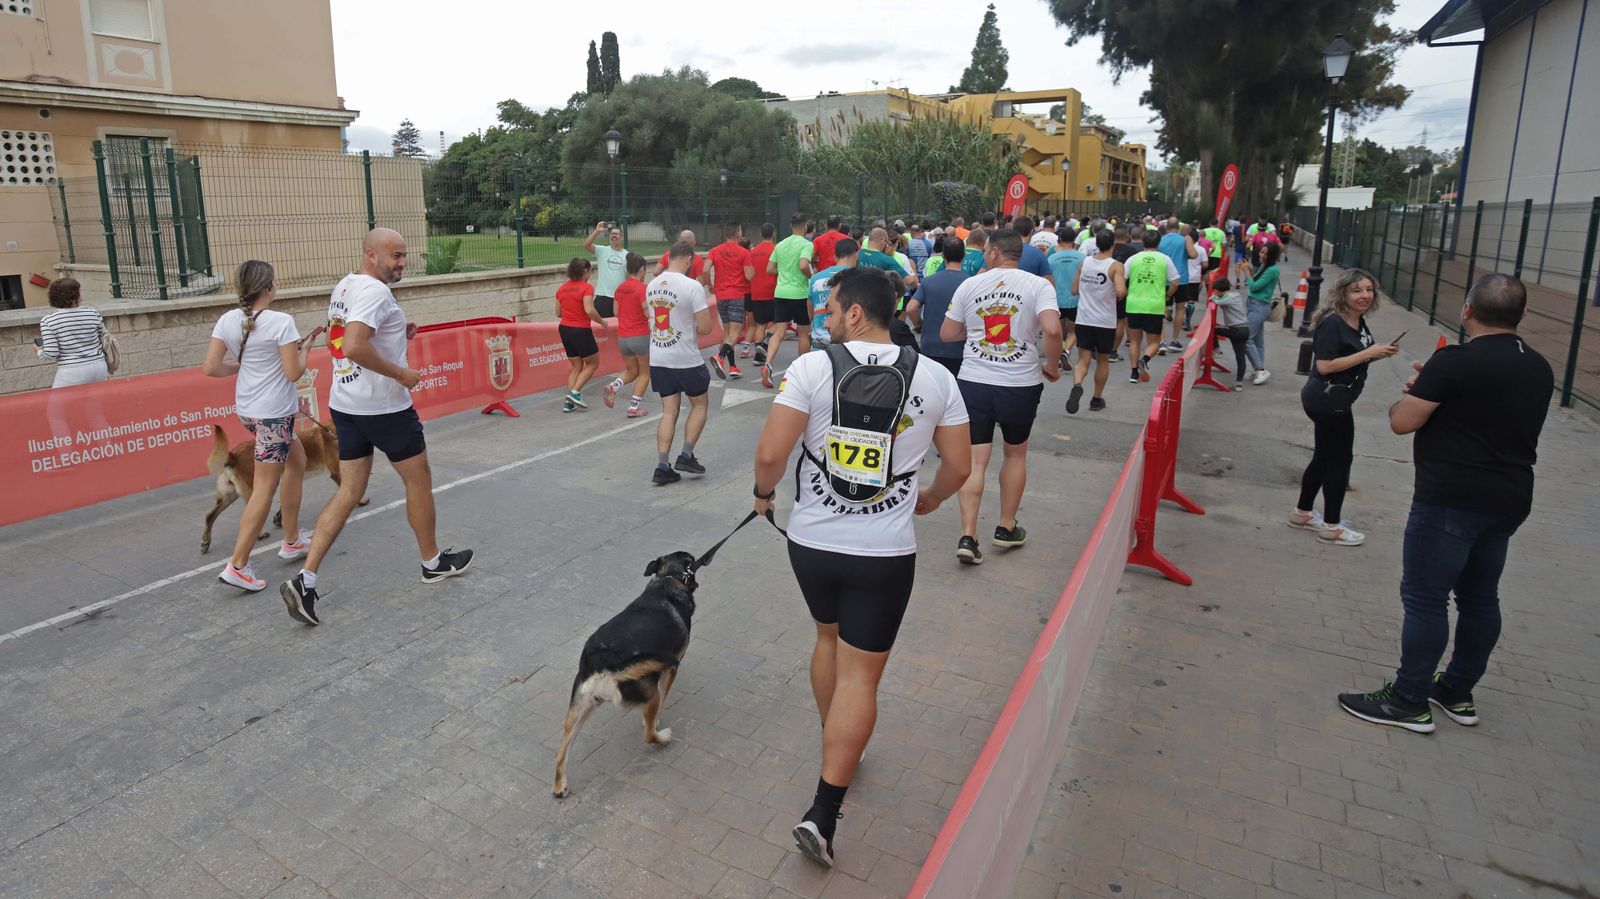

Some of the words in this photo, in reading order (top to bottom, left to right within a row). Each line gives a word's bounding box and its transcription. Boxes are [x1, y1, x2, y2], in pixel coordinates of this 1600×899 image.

[974, 291, 1023, 305] HECHOS,
[429, 364, 442, 375] San
[443, 360, 464, 371] Roque
[28, 435, 73, 453] Ilustre
[76, 419, 161, 445] Ayuntamiento
[163, 415, 178, 427] de
[180, 411, 202, 424] San
[204, 404, 237, 418] Roque
[31, 442, 125, 473] DELEGACIÓN
[127, 439, 145, 451] DE
[147, 424, 212, 449] DEPORTES
[830, 442, 881, 468] 178
[810, 472, 824, 496] NO
[822, 477, 912, 514] PALABRAS
